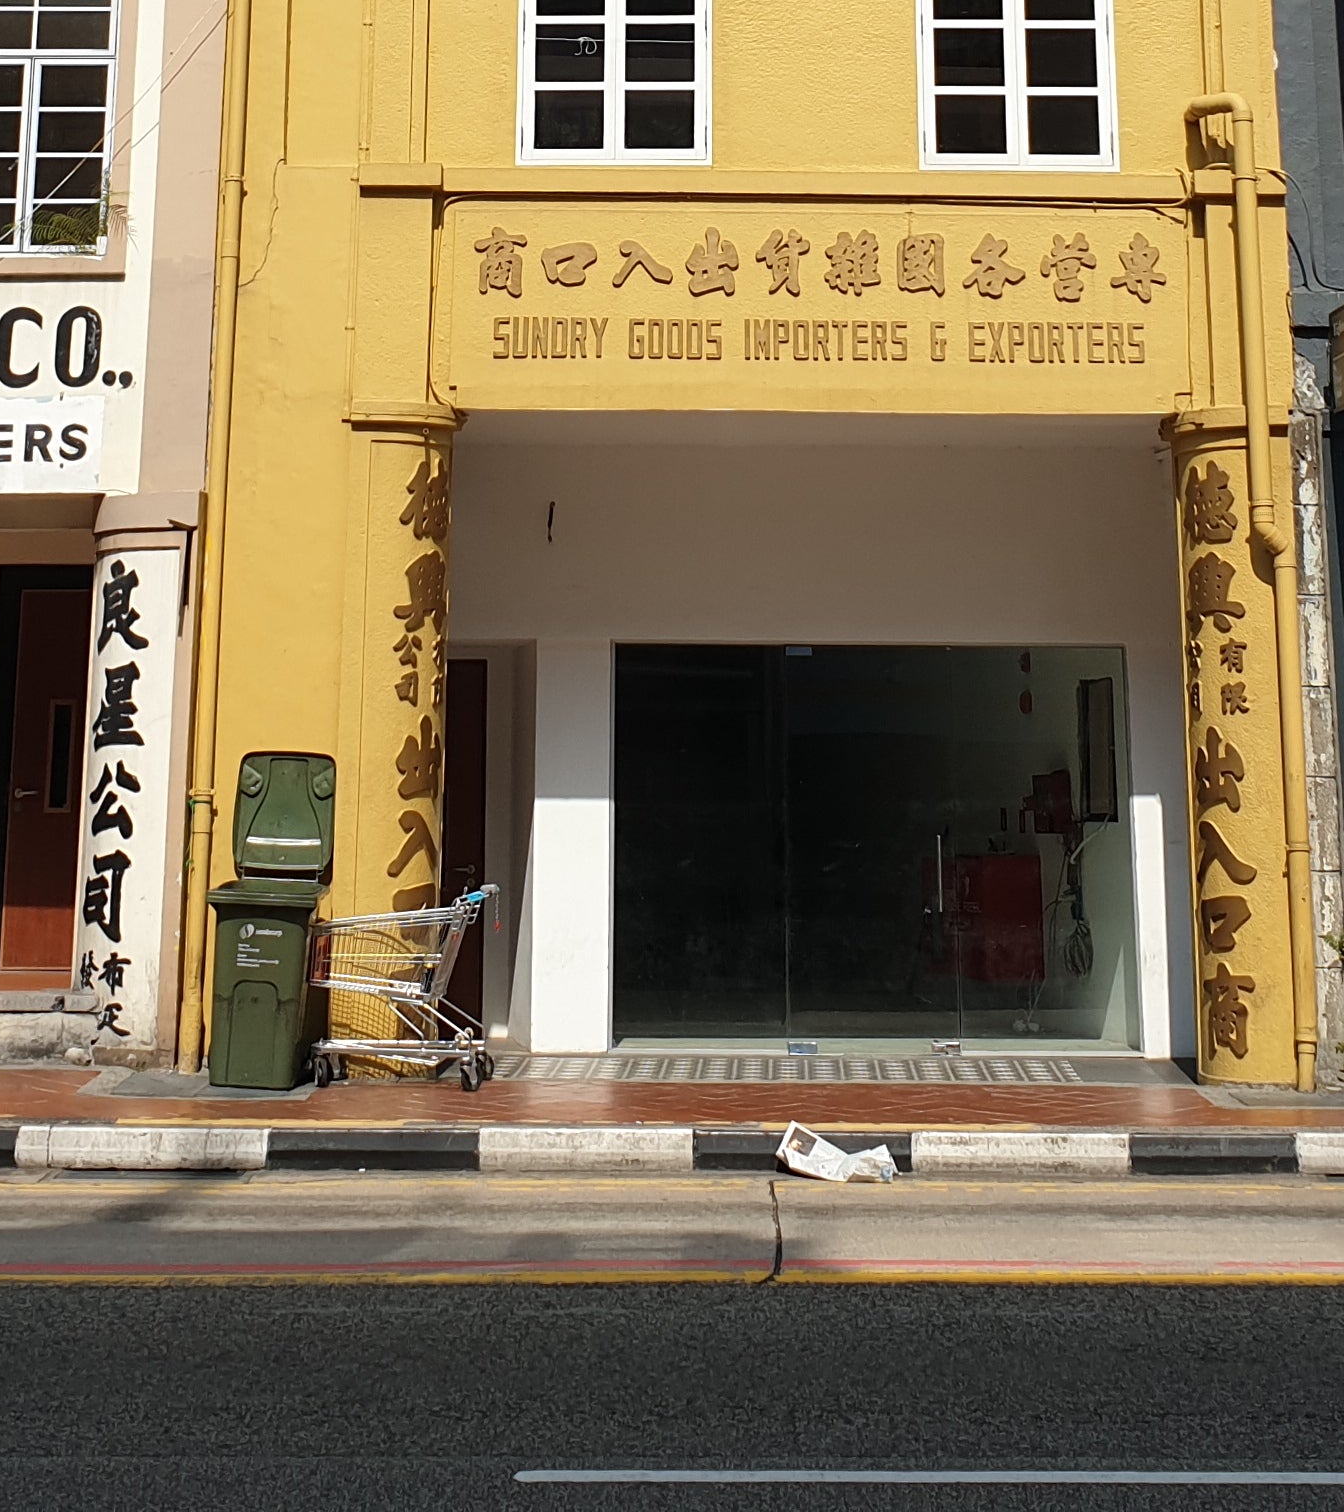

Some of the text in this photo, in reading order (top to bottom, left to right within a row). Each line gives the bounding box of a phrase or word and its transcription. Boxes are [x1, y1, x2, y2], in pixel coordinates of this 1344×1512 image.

[493, 316, 609, 361] SUNDRY
[627, 318, 723, 362] GOODS
[744, 319, 909, 364] IMPORTERS
[967, 320, 1146, 365] EXPORTERS
[82, 559, 150, 944] 良星公司
